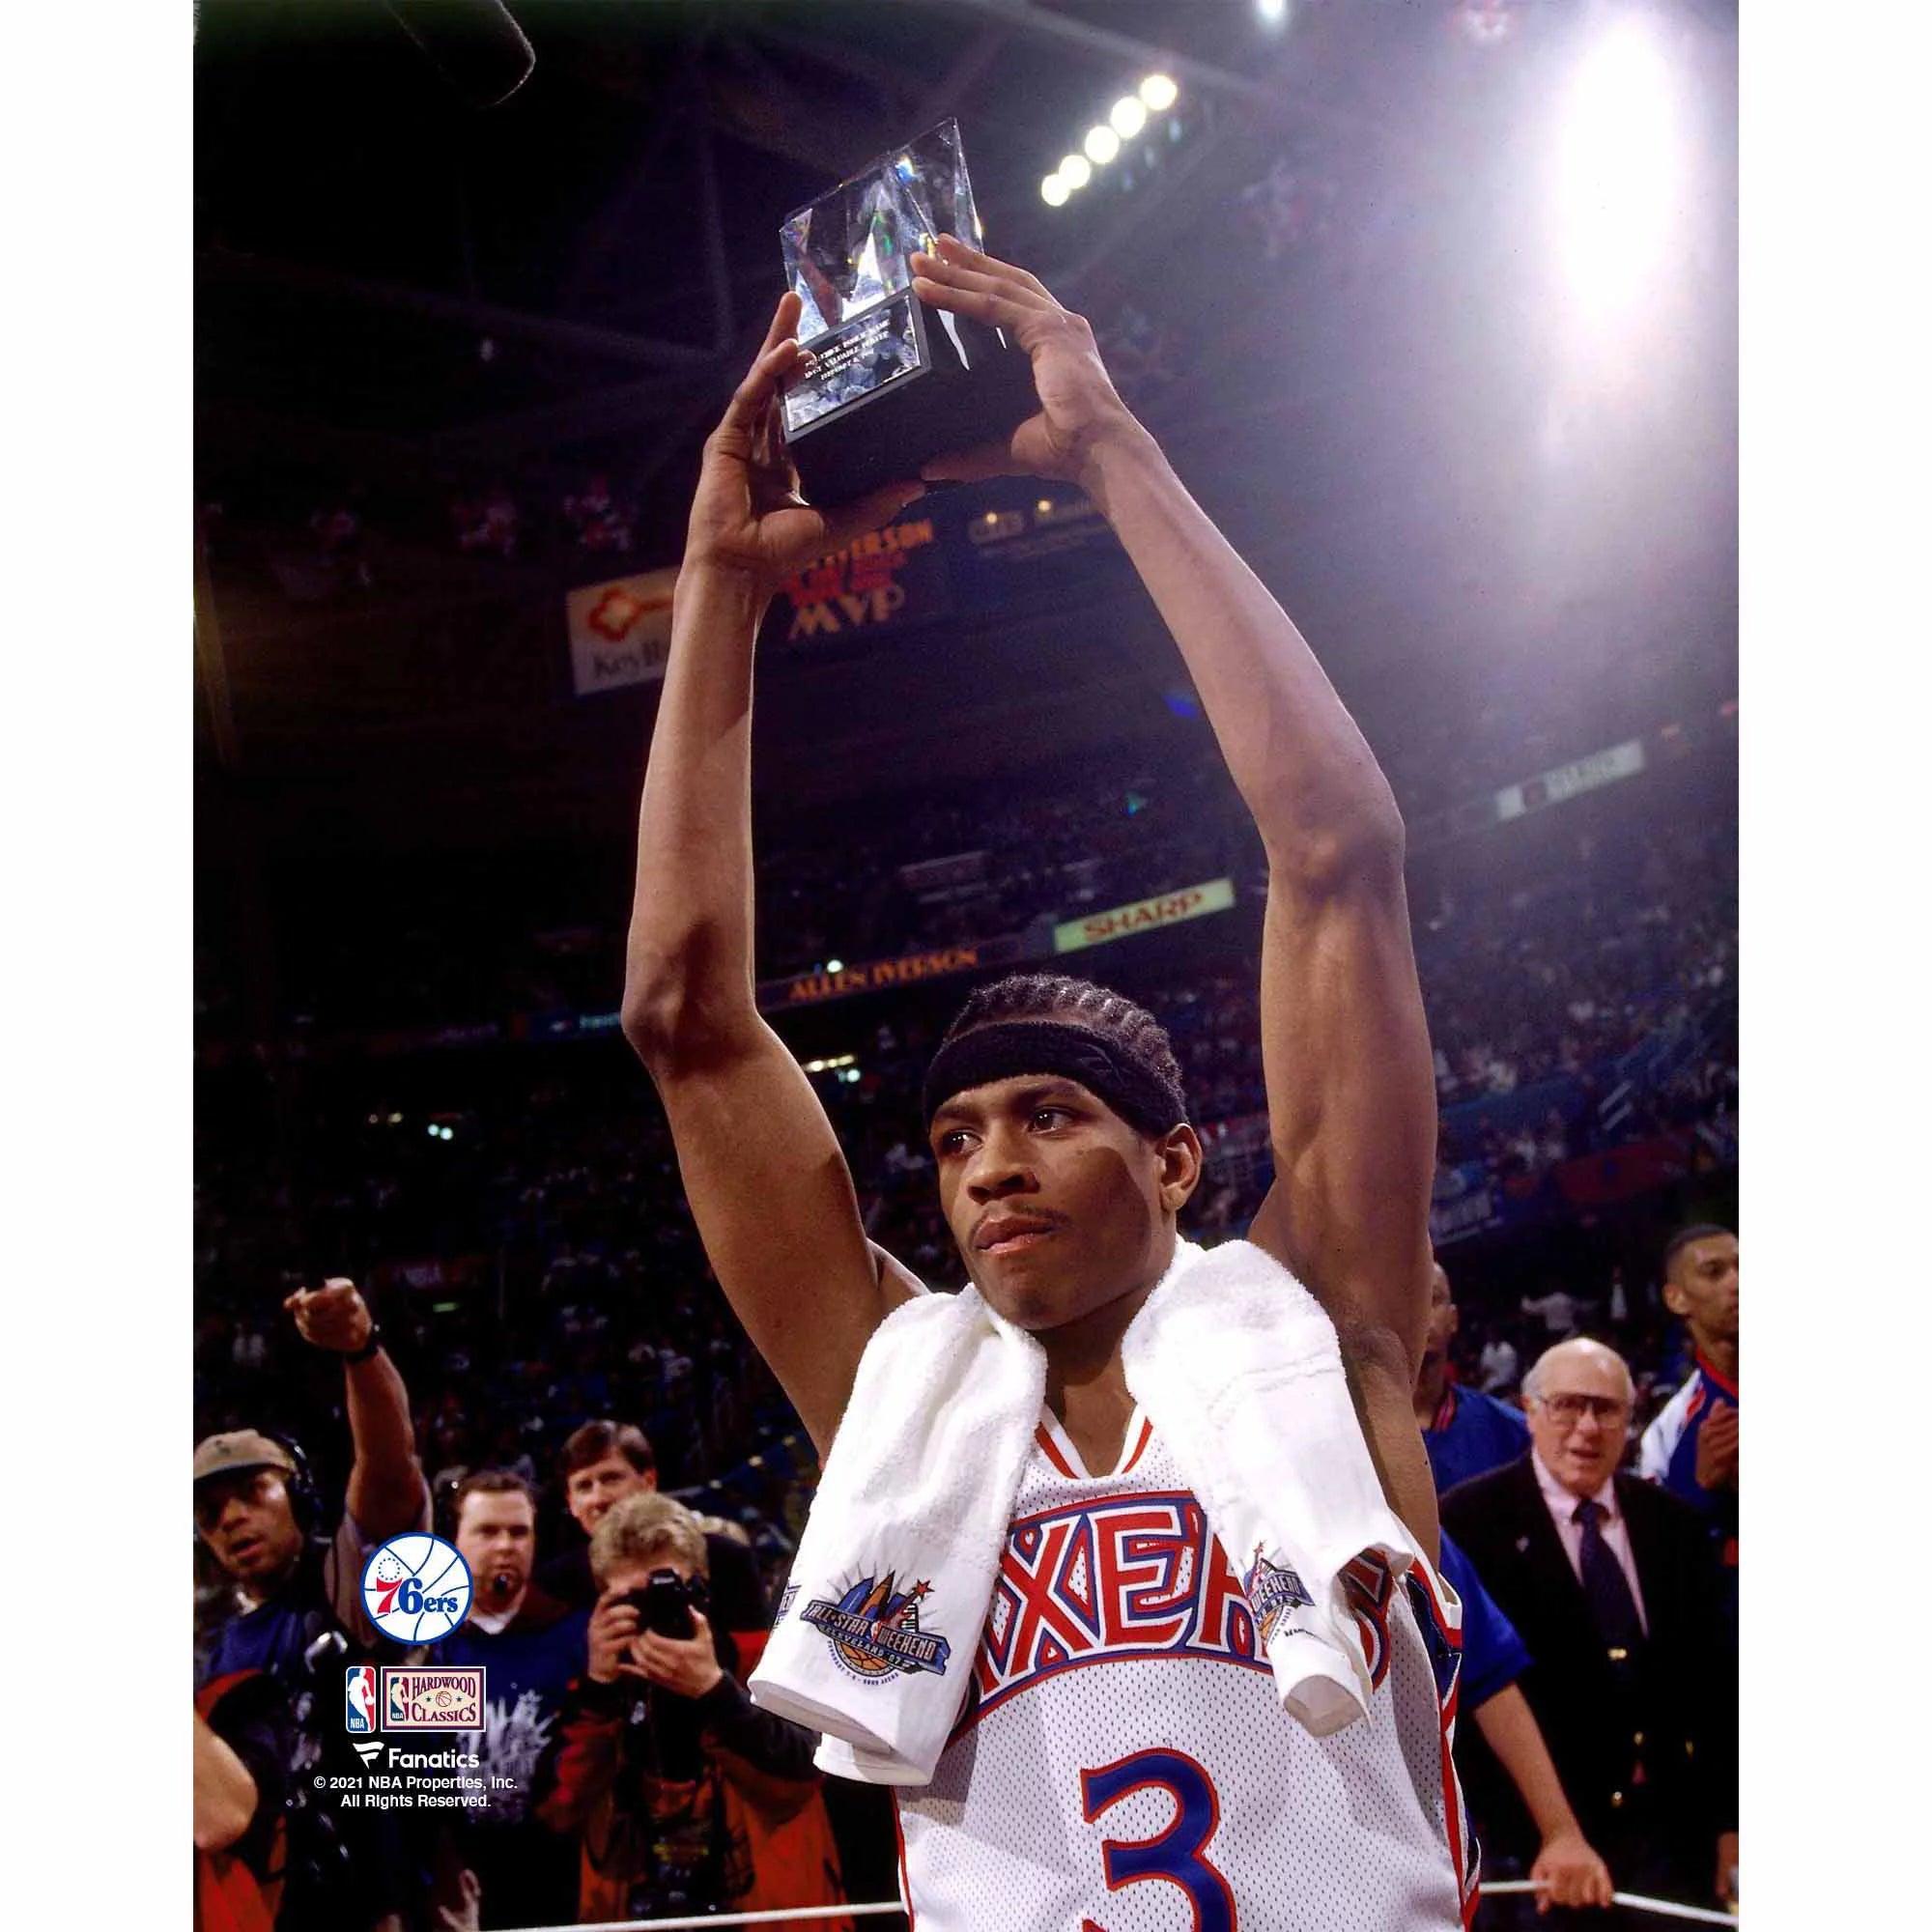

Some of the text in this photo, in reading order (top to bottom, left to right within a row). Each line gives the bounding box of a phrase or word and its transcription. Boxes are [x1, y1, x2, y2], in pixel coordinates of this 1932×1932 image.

[788, 584, 905, 640] MVP
[1082, 892, 1204, 943] SHARP
[789, 950, 978, 1001] ALLEN IVERSON
[877, 1627, 937, 1662] WEEKEND
[1080, 1747, 1237, 1932] 3
